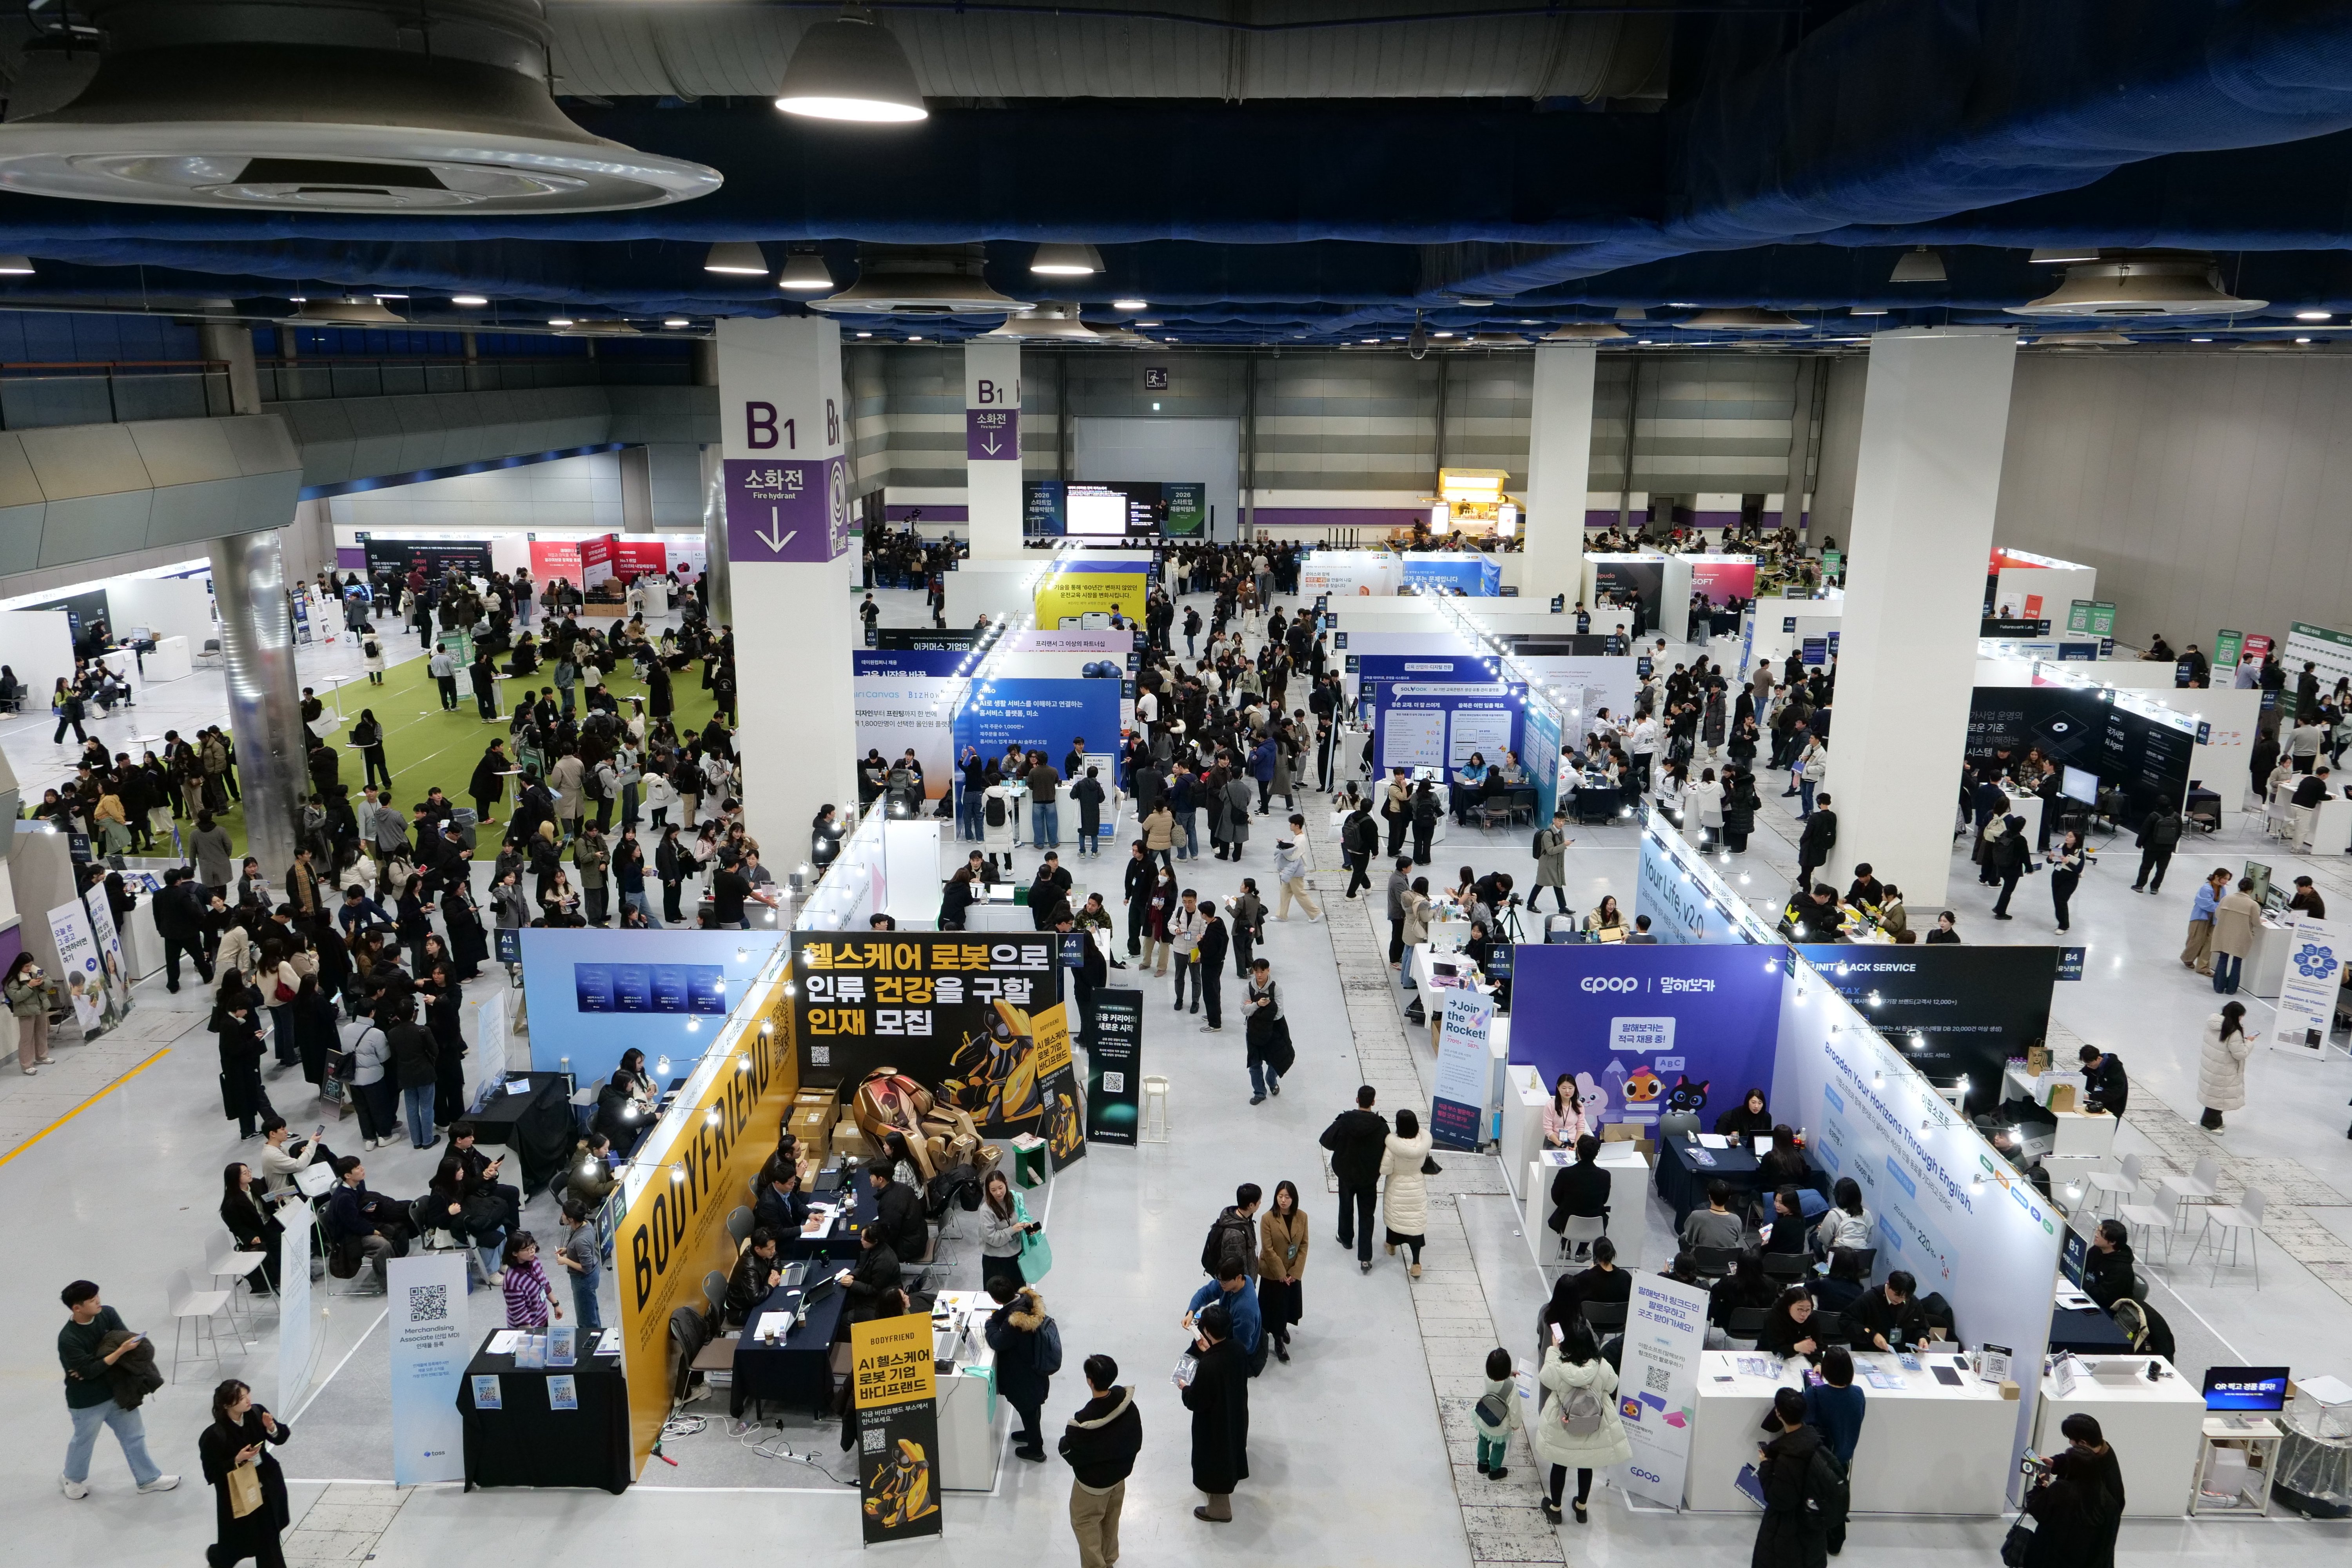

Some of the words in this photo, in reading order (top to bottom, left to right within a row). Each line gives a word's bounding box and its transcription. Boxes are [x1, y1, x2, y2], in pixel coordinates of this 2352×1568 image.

[978, 380, 1002, 403] B1
[746, 401, 795, 449] B1
[827, 399, 840, 446] B1
[977, 414, 1006, 424] 소화전
[744, 469, 803, 490] 소화전
[914, 642, 944, 651] 이커머스
[1005, 710, 1025, 718] 플랫폼,
[1998, 711, 2023, 720] 운영의
[1985, 736, 2020, 745] 이해하는
[2110, 739, 2123, 751] Agent
[1644, 852, 1663, 890] Your
[843, 896, 858, 929] financial
[858, 880, 869, 905] service
[54, 927, 66, 937] 오늘
[66, 924, 73, 932] 본
[64, 933, 76, 944] 공고
[60, 937, 88, 955] 합격하려면
[63, 954, 74, 963] 여기
[804, 943, 921, 971] 헬스케어
[931, 944, 1050, 971] 로봇으로
[1493, 951, 1506, 959] B1
[2065, 953, 2078, 961] B4
[1873, 964, 1917, 972] SERVICE
[806, 976, 866, 1003] 인류
[875, 976, 964, 1004] 건강을
[973, 977, 1033, 1004] 구할
[1660, 977, 1716, 994] 말해보카
[1457, 1001, 1480, 1013] Join
[807, 1009, 866, 1036] 인재
[875, 1009, 932, 1036] 모집
[1095, 1013, 1109, 1022] 금융
[1109, 1014, 1137, 1024] 커리어의
[1448, 1010, 1465, 1023] the
[1040, 1018, 1060, 1033] BODYFRIEND
[1098, 1023, 1119, 1032] 새로운
[1120, 1025, 1134, 1033] 시작
[1446, 1022, 1486, 1041] Rocket!
[1622, 1024, 1664, 1033] 말해보카는
[1036, 1041, 1044, 1051] AI
[1044, 1028, 1067, 1045] 헬스케어
[1618, 1035, 1635, 1044] 적극
[1636, 1035, 1653, 1044] 채용
[1655, 1035, 1666, 1044] 중!
[1038, 1049, 1049, 1061] 로봇
[1050, 1043, 1062, 1054] 기업
[1038, 1051, 1068, 1072] 바디프랜드
[1922, 1093, 1950, 1131] 이팝소프트
[1825, 1041, 1853, 1079] Broaden
[1854, 1073, 1869, 1098] Your
[1870, 1091, 1902, 1135] Horizons
[1904, 1127, 1938, 1174] Through
[1939, 1166, 1973, 1215] English.
[632, 1030, 769, 1314] BODYFRIEND
[2069, 1238, 2080, 1256] B1
[1638, 1286, 1668, 1302] 말해보카
[1669, 1296, 1699, 1313] 링크드인
[1648, 1301, 1686, 1319] 팔로우하고
[1638, 1308, 1652, 1320] 굿즈
[1654, 1314, 1694, 1333] 받아가세요!
[405, 1325, 454, 1334] Merchandising
[400, 1335, 434, 1343] Associate
[870, 1332, 915, 1345] BODYFRIEND
[858, 1357, 874, 1371] AI
[877, 1349, 930, 1368] 헬스케어
[1638, 1350, 1658, 1361] 링크드인
[1659, 1356, 1683, 1370] 팔로우하기
[859, 1370, 886, 1385] 로봇
[889, 1365, 916, 1381] 기업
[860, 1379, 927, 1400] 바디프랜드
[875, 1406, 904, 1416] 바디프랜드
[905, 1402, 928, 1412] 부스에서
[862, 1416, 893, 1425] 만나보세요.
